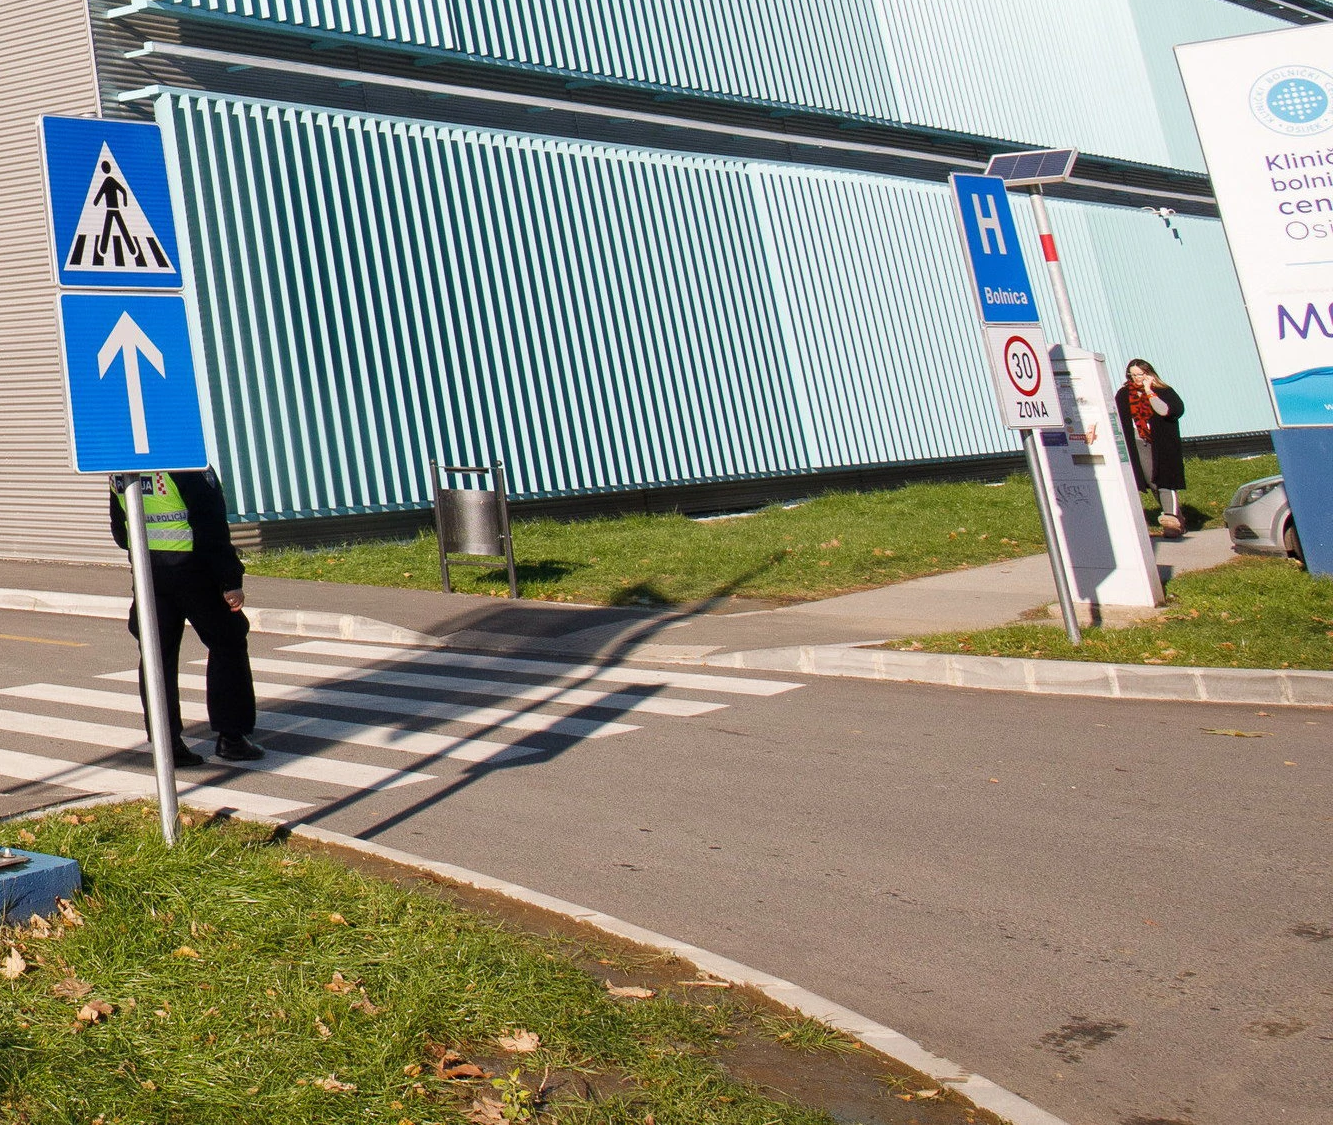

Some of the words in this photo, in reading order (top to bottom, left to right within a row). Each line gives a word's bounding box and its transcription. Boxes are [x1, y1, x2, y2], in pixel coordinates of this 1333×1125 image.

[1279, 198, 1333, 215] cen
[971, 193, 1007, 255] H
[984, 287, 1028, 305] Bolnica
[1012, 353, 1033, 379] 30
[1017, 401, 1049, 418] ZONA
[156, 512, 188, 523] POLICIJ
